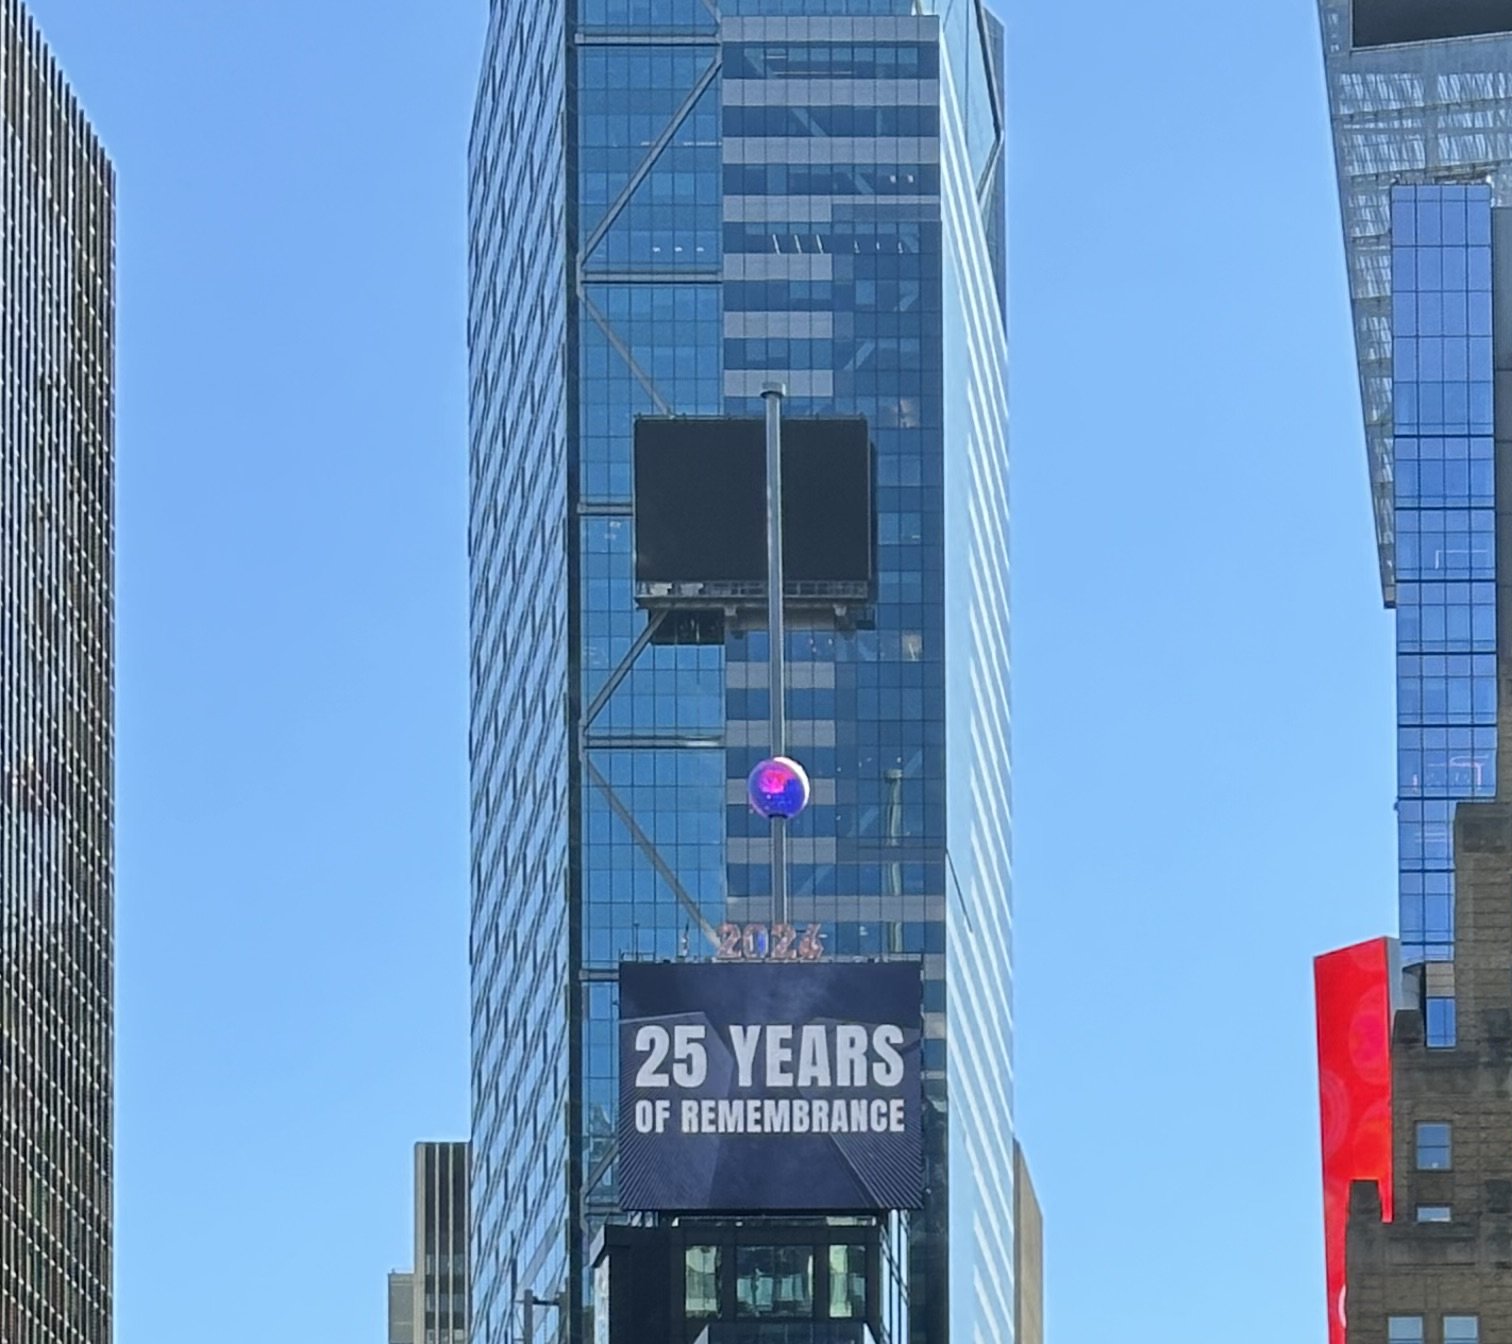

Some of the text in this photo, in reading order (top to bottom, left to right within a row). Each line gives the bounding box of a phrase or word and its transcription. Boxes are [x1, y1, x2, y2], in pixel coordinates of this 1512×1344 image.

[635, 1024, 904, 1088] 25 YEARS
[635, 1099, 905, 1134] OF REMEMBRANCE
